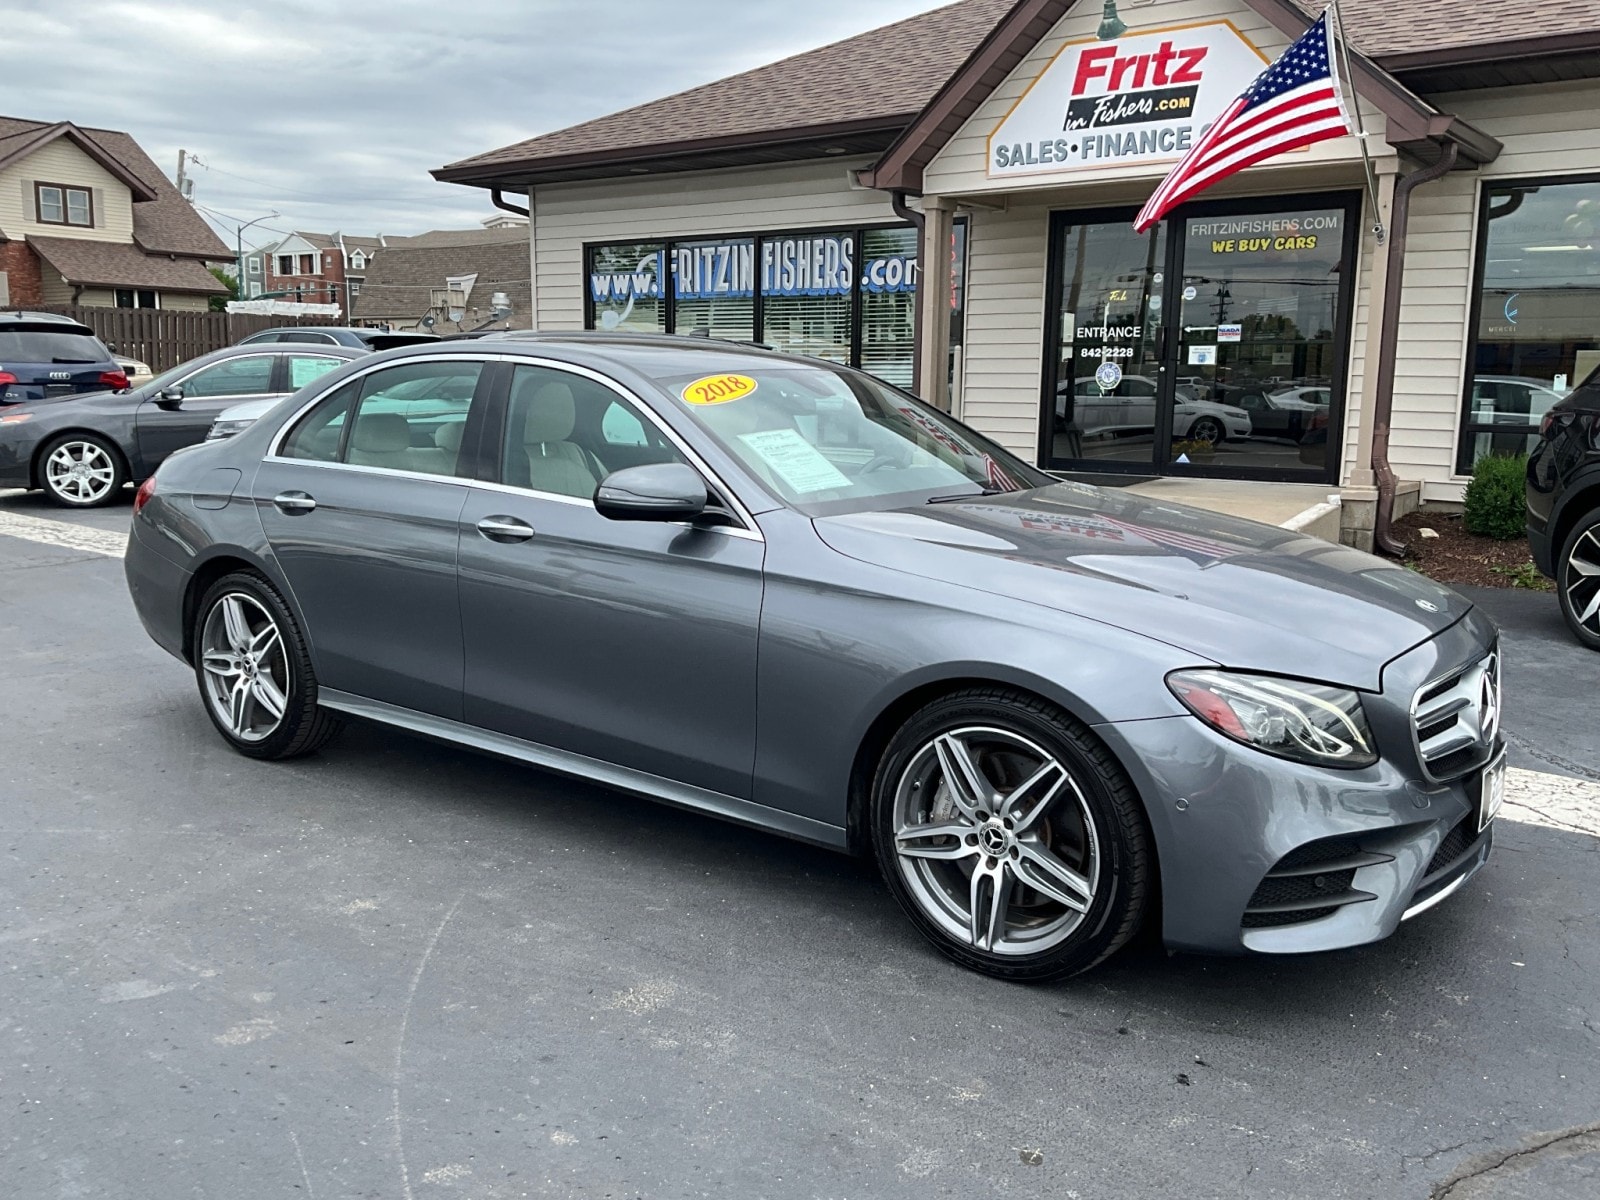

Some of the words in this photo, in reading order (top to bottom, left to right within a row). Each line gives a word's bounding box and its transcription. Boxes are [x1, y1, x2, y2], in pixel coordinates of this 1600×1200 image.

[1071, 41, 1209, 96] Fritz
[1065, 111, 1087, 131] in
[1191, 216, 1338, 236] FRITZINFISHERS.COM
[1211, 239, 1235, 253] WE
[1238, 237, 1271, 252] BUY
[1274, 235, 1317, 251] CARS
[1076, 326, 1141, 338] ENTRANCE
[1080, 347, 1134, 358] 842-2228
[695, 376, 748, 403] 2018
